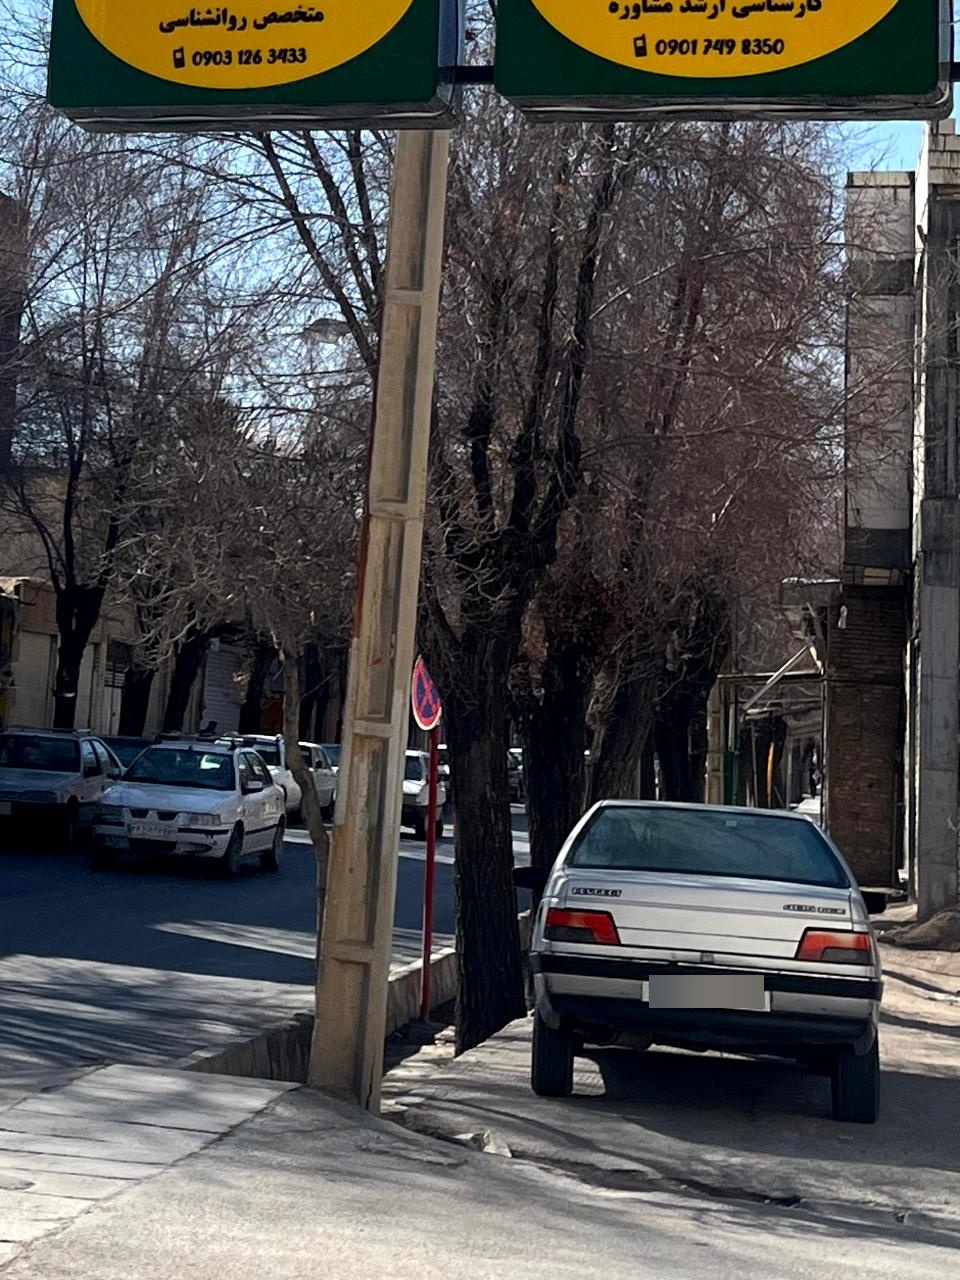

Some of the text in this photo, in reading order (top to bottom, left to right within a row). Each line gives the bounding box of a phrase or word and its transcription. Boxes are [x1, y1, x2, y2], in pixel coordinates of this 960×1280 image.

[158, 5, 325, 35] متخصص روانشناسی
[655, 37, 785, 56] 0901 749 8350
[191, 49, 233, 67] 0903
[236, 48, 263, 66] 126
